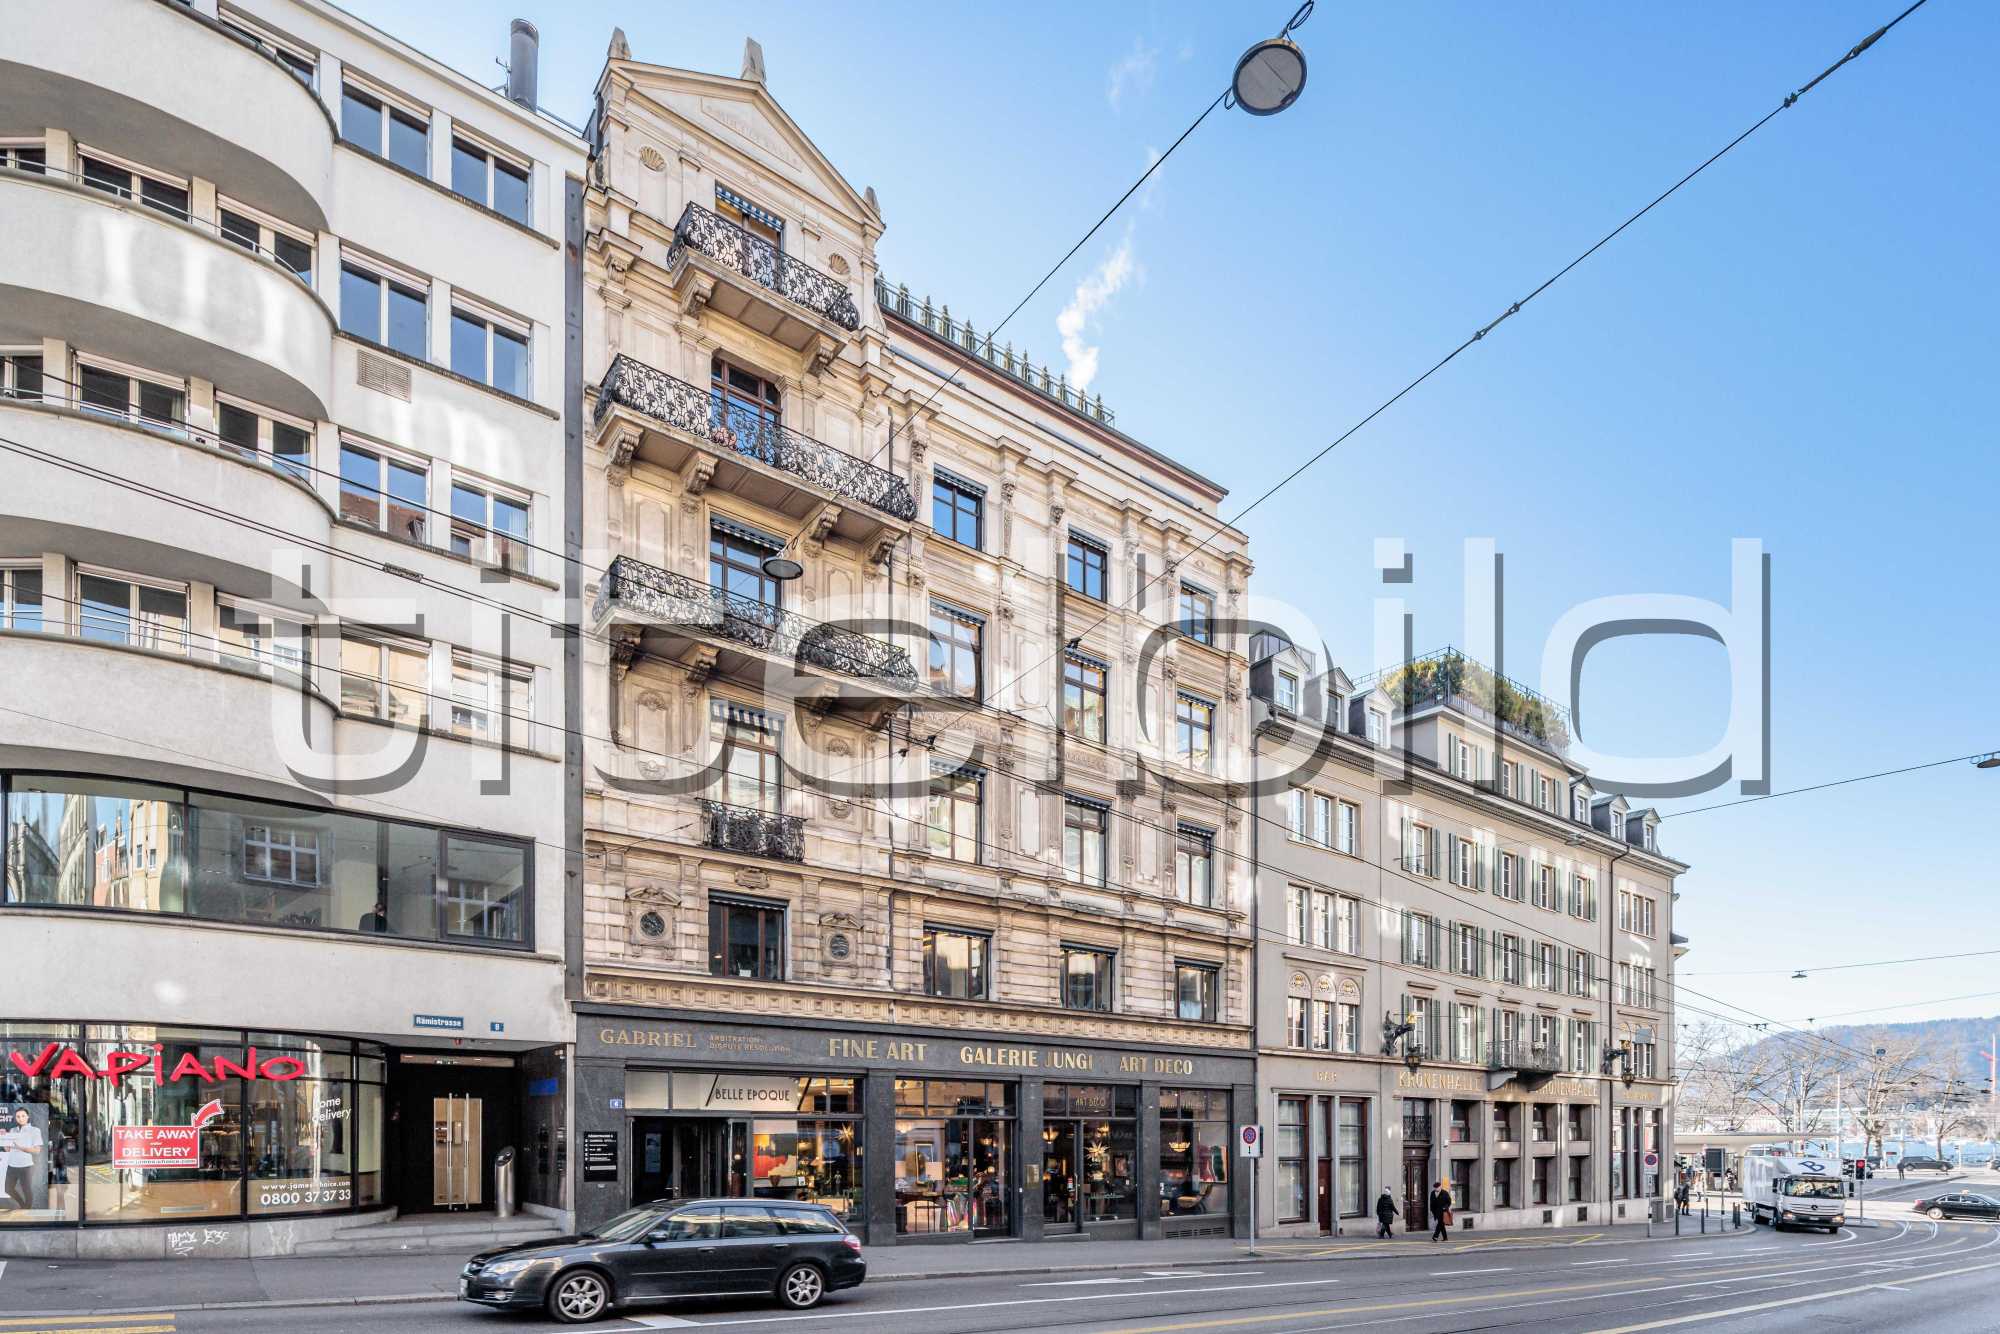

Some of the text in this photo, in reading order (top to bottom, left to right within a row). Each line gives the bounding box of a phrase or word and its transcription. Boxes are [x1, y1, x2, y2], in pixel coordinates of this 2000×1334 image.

[600, 1029, 697, 1048] GABRIEL
[828, 1038, 928, 1061] FINE ART
[960, 1046, 1038, 1067] GALERIE
[1119, 1056, 1193, 1075] ART DECO
[715, 1089, 791, 1101] BELLE EPOQUE
[116, 1130, 196, 1139] TAKE AWAY
[122, 1147, 191, 1157] DELIVERY
[260, 1189, 351, 1205] 0800 37 37 33
